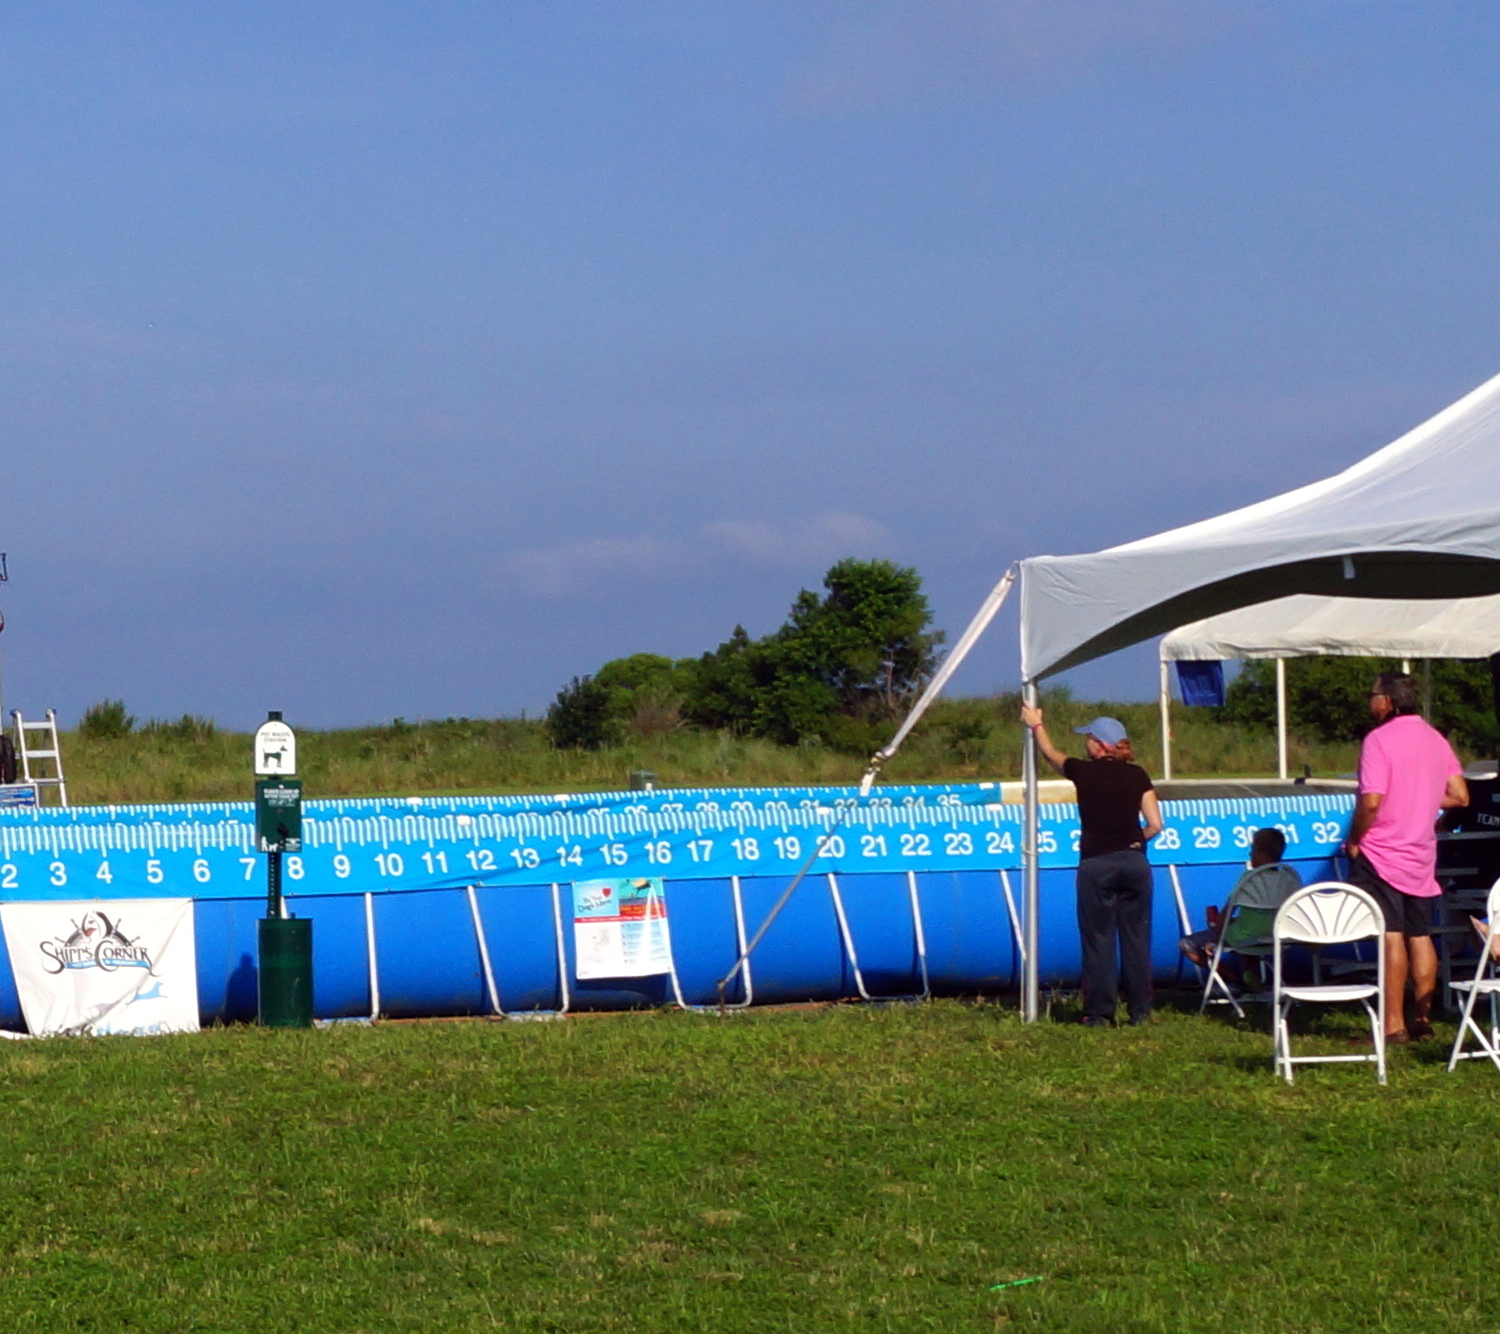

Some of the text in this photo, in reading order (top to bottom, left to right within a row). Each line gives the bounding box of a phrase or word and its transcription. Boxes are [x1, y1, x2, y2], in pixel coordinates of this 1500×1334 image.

[1, 864, 19, 889] 2
[50, 861, 67, 886] 3
[96, 860, 113, 884] 4
[147, 859, 164, 883] 5
[193, 858, 211, 882] 6
[239, 857, 256, 881] 7
[287, 856, 304, 879] 8
[333, 854, 350, 878] 9
[374, 853, 403, 877] 10
[422, 851, 448, 874] 11
[466, 849, 497, 871] 12
[510, 848, 540, 869] 13
[556, 845, 583, 867] 14
[600, 843, 628, 866] 15
[644, 841, 672, 864] 16
[687, 840, 713, 862] 17
[730, 837, 760, 860] 18
[773, 836, 801, 860] 19
[816, 835, 845, 858] 20
[860, 834, 888, 857] 21
[900, 833, 932, 856] 22
[944, 832, 973, 855] 23
[985, 831, 1014, 855] 24
[1154, 828, 1181, 850] 28
[1192, 827, 1220, 849] 29
[1312, 821, 1343, 844] 32
[95, 940, 157, 977] CORNER
